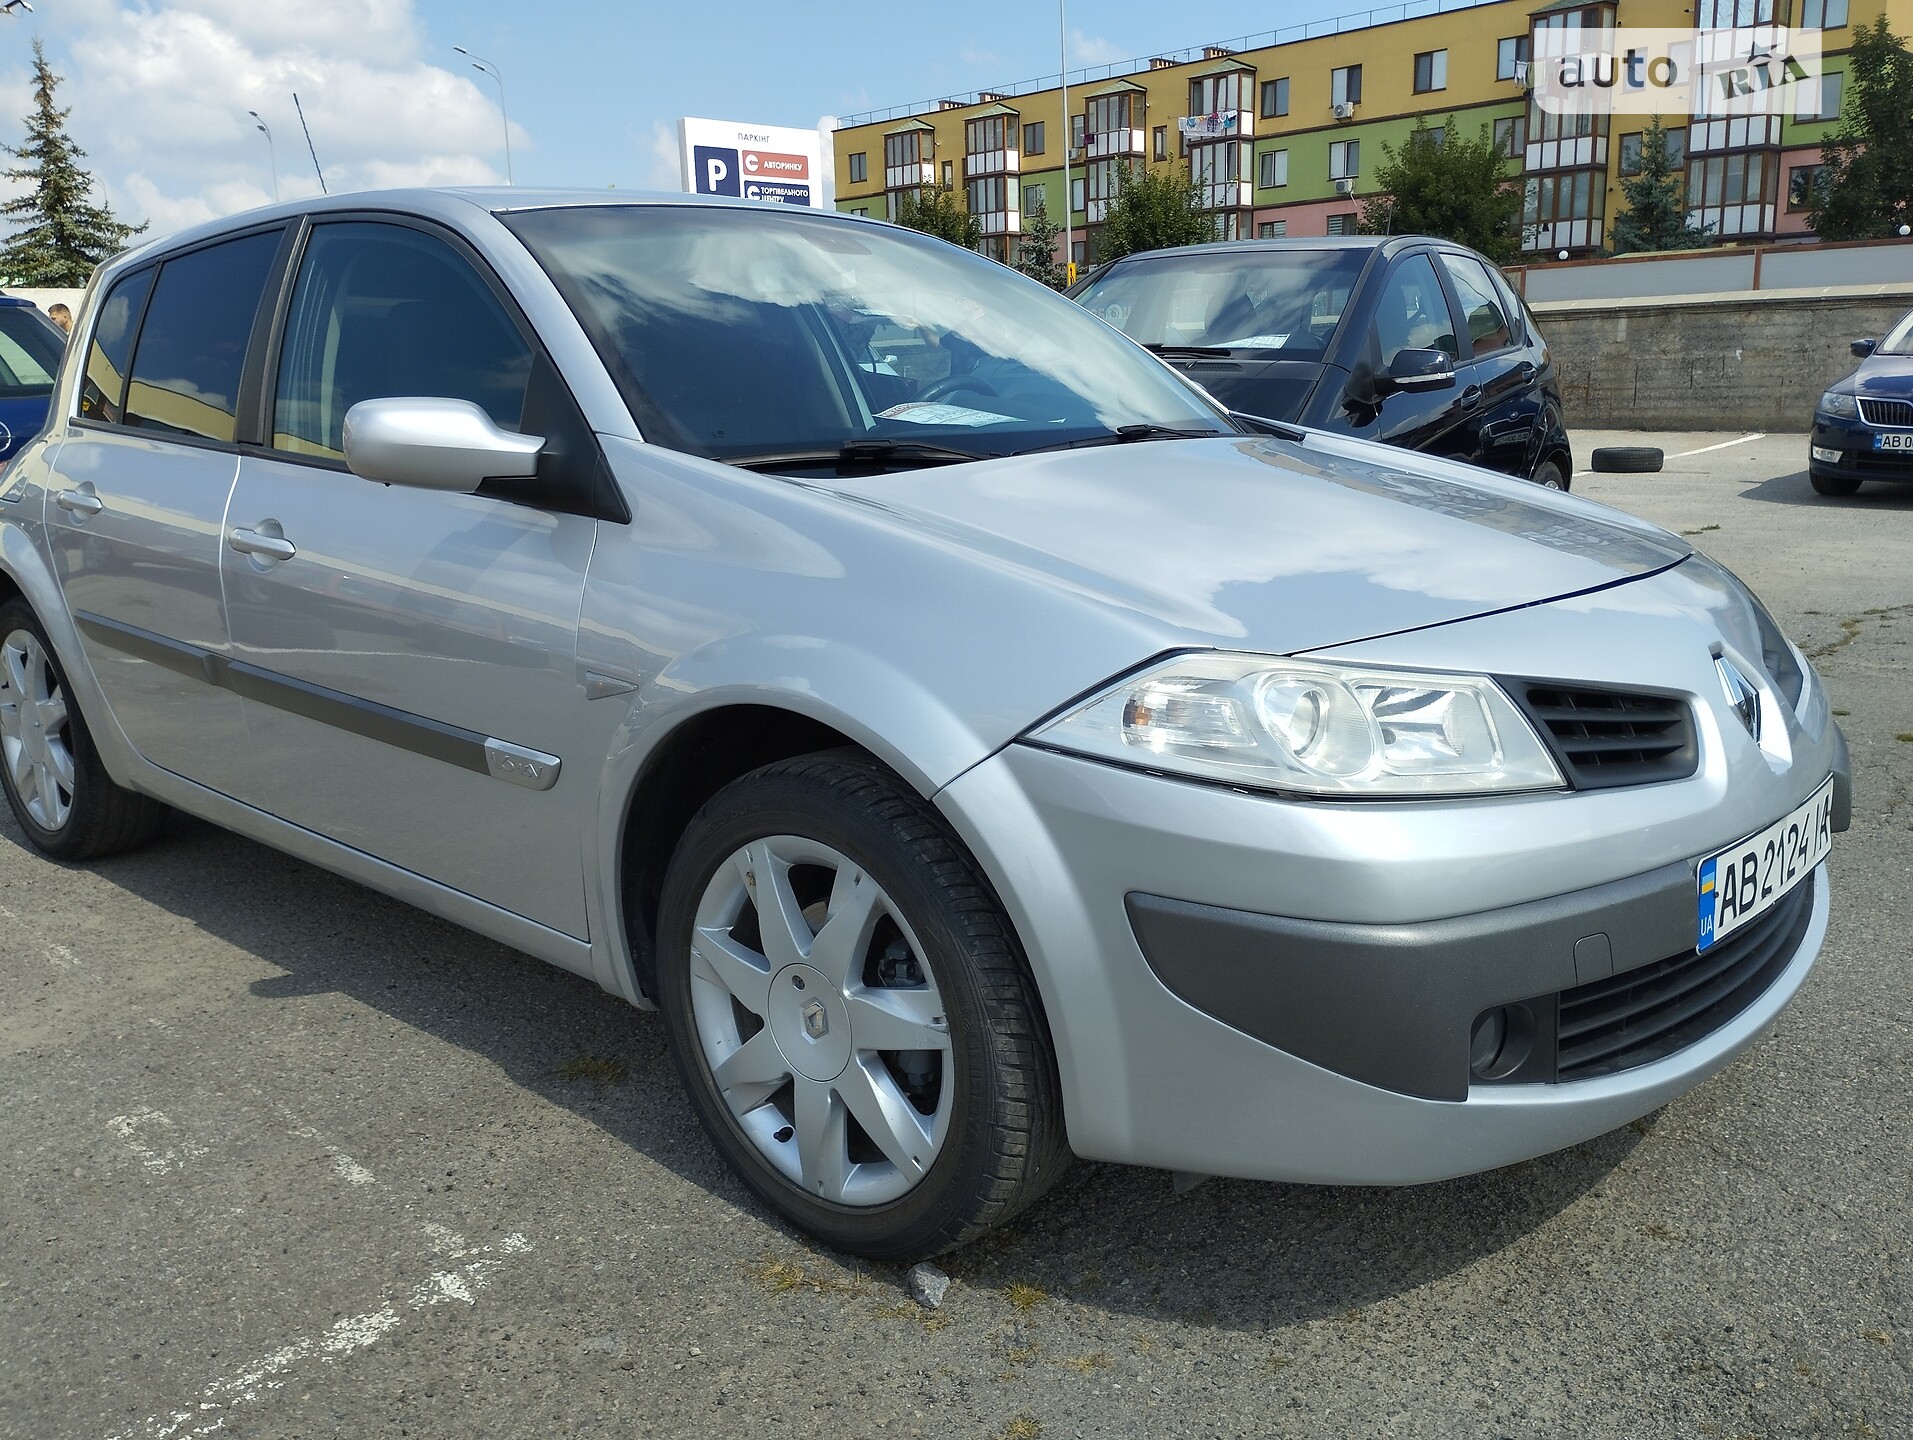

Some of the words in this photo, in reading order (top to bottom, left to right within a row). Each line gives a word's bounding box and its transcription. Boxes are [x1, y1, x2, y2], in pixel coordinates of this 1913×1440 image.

[738, 133, 769, 143] ПАРКІНГ
[764, 161, 802, 171] АВТОРИНКУ
[1882, 436, 1900, 448] AB
[1905, 437, 1913, 448] 0
[1700, 914, 1713, 936] UA
